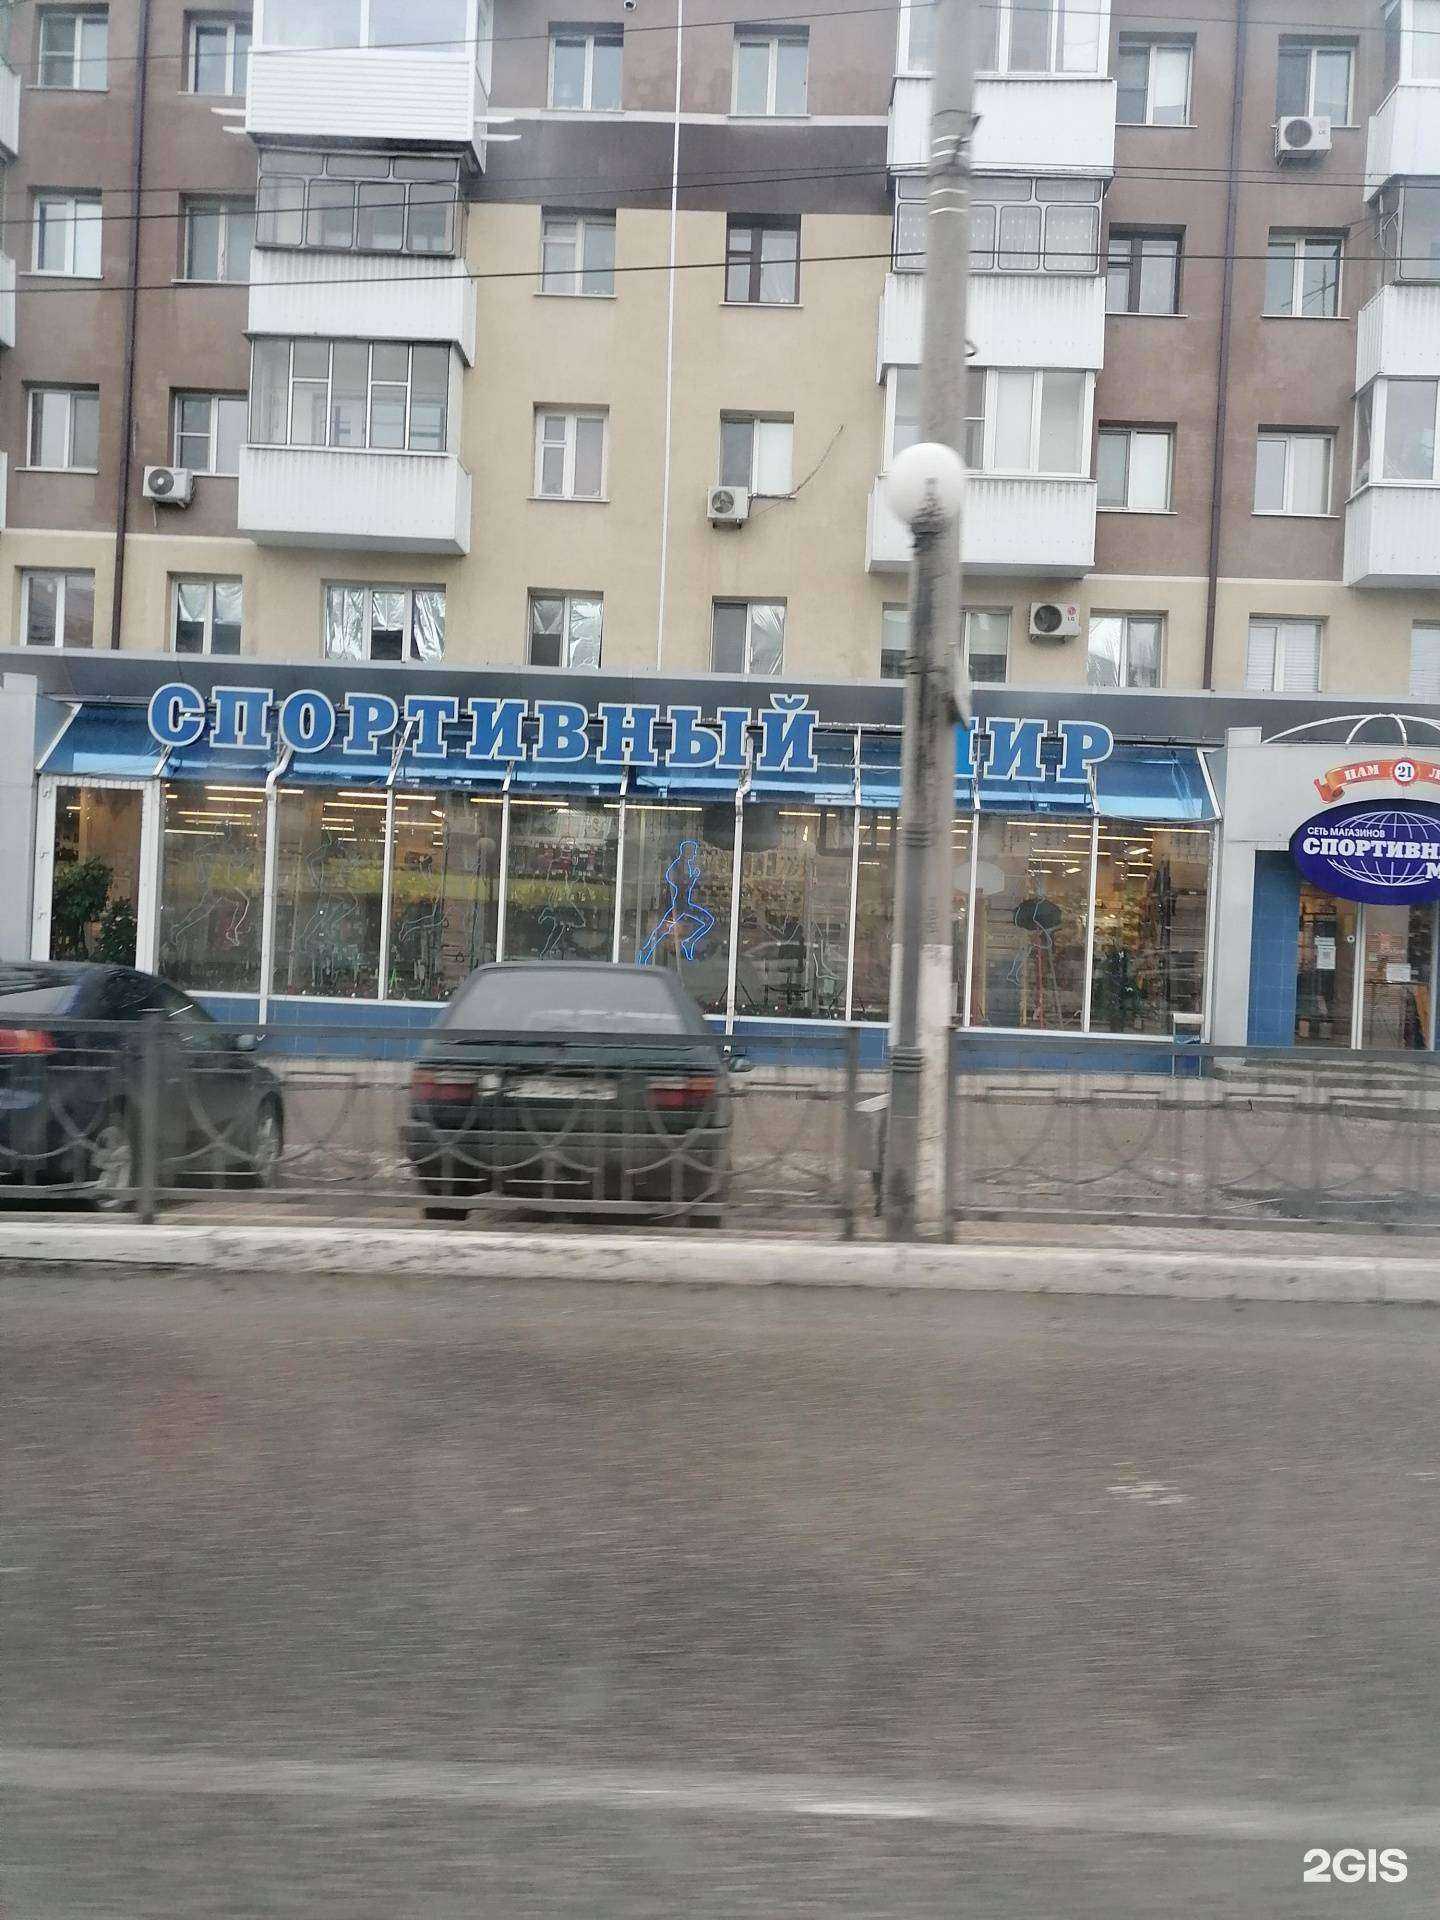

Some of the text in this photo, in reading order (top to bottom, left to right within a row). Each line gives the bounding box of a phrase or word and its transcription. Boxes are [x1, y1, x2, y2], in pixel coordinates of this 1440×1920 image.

[147, 682, 819, 772] СПОРТИВНЫЙ
[1397, 766, 1412, 778] 21
[1307, 826, 1386, 838] СЕТЬ МАГАЗИНОВ
[1303, 838, 1440, 860] СПОРТИВН
